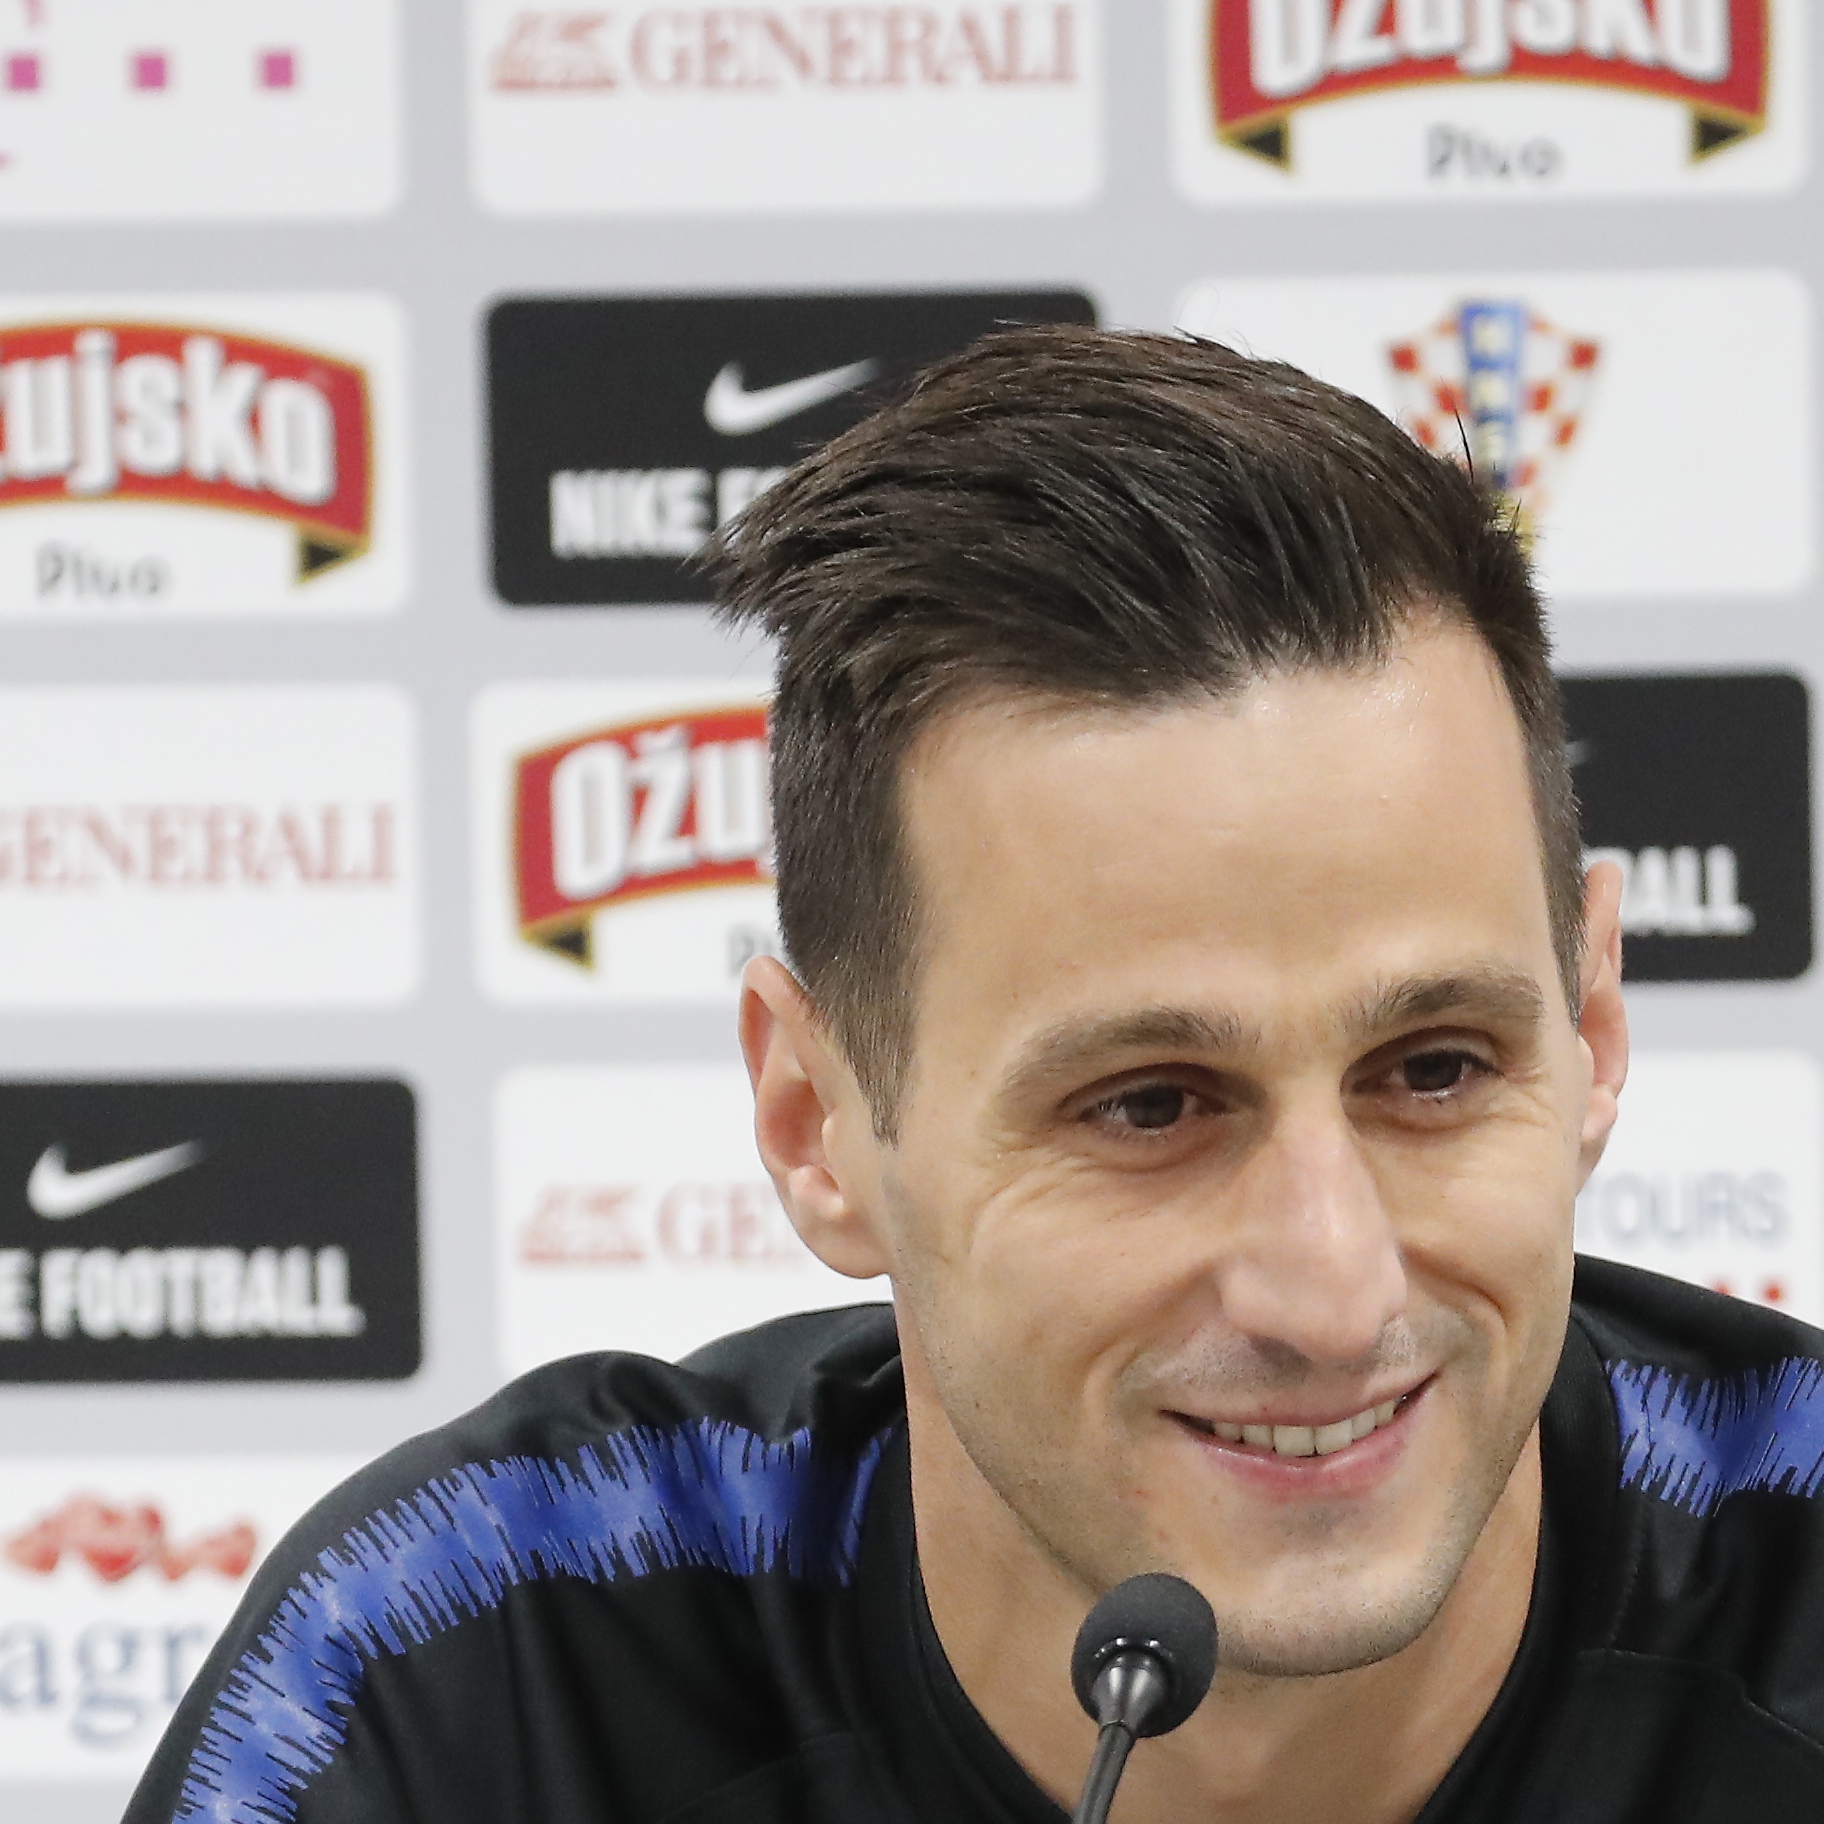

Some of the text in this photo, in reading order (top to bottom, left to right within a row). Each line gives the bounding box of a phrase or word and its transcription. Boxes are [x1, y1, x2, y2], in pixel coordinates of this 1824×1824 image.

[629, 6, 1078, 91] GENERALI
[551, 469, 711, 558] NIKE
[40, 1248, 364, 1338] FOOTBALL
